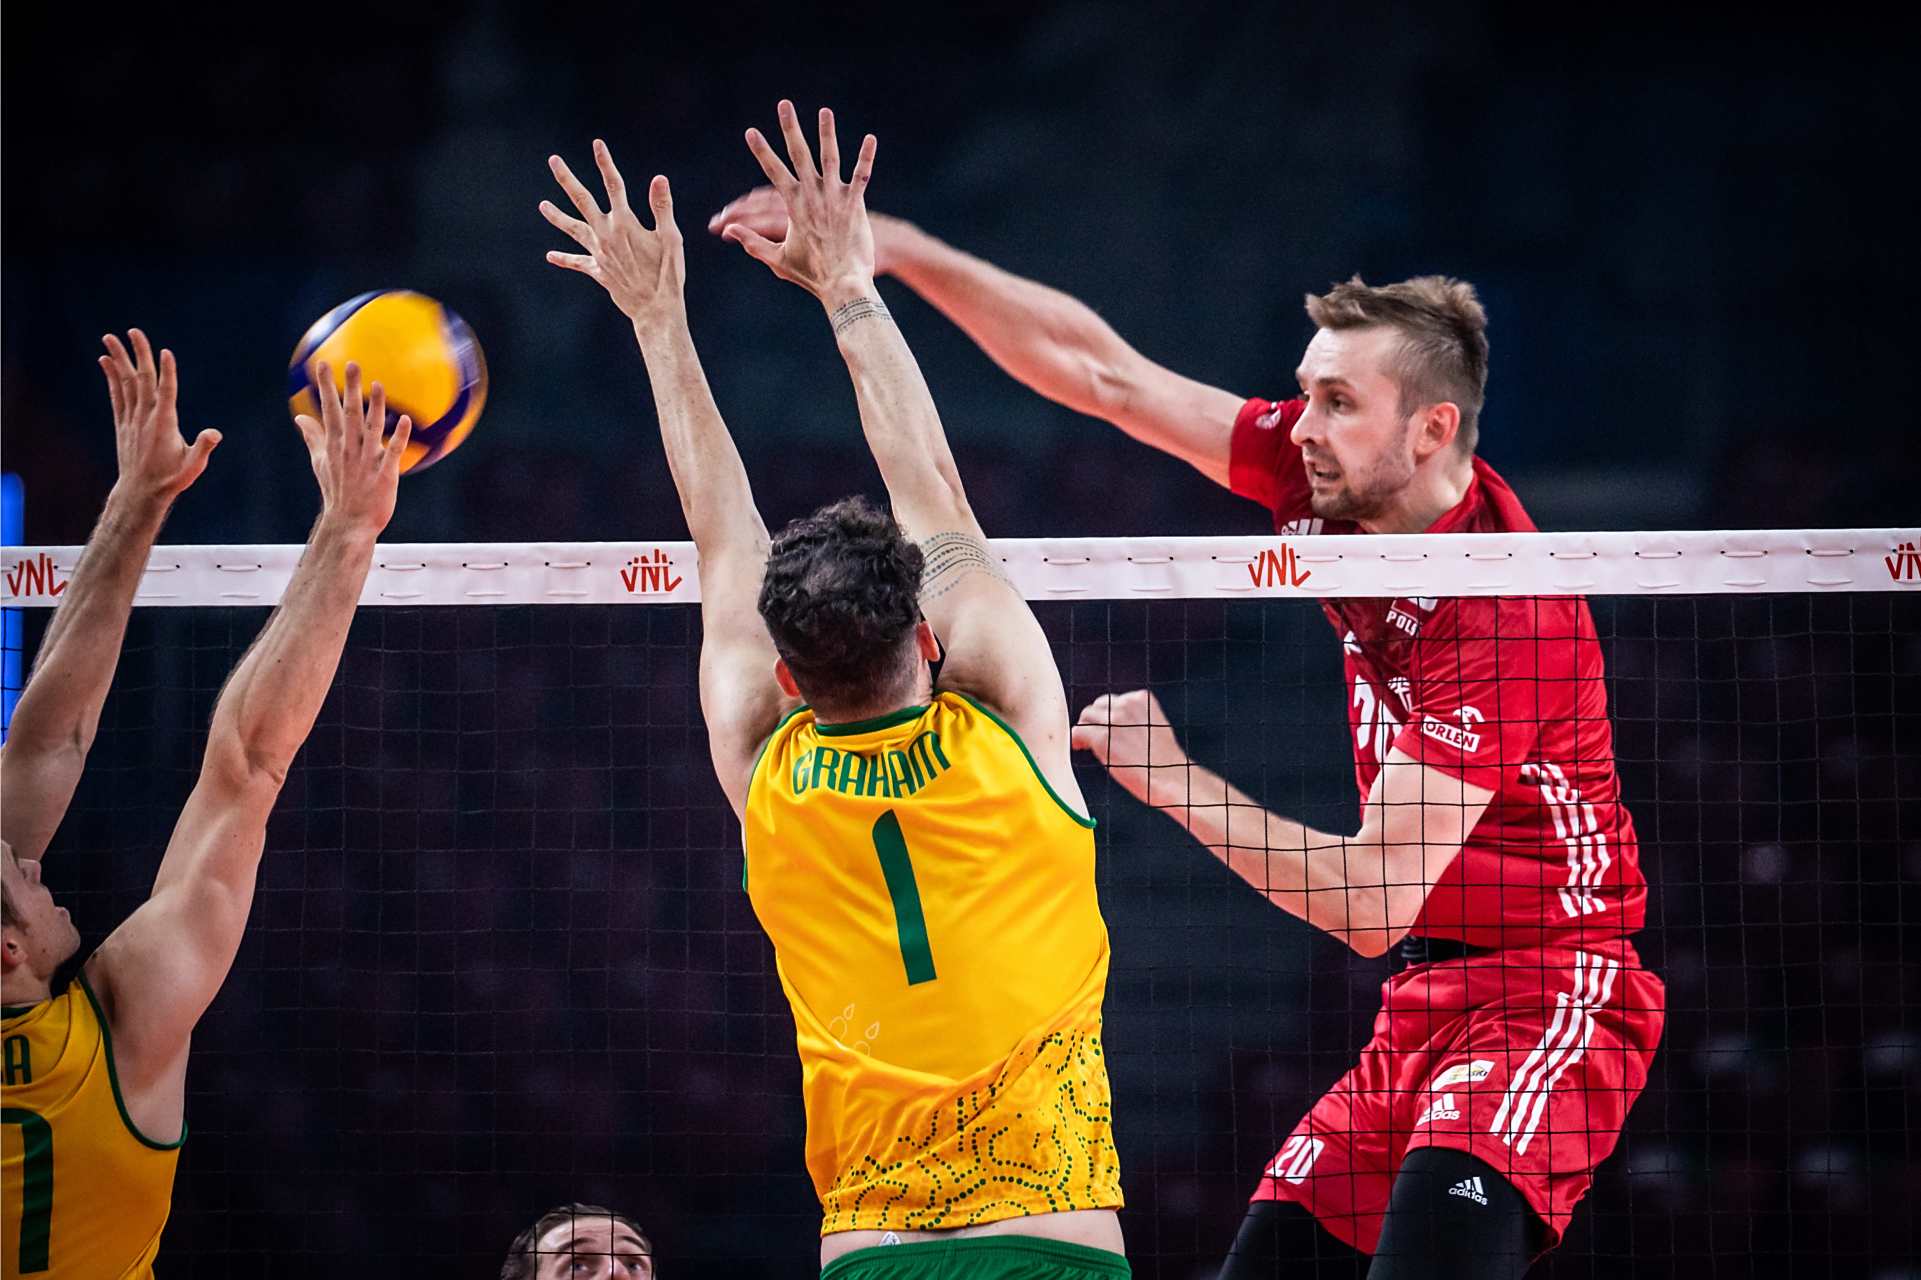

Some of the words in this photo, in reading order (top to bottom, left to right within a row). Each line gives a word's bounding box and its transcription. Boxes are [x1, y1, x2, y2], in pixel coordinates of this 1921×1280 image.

[7, 552, 68, 597] VNL
[620, 549, 682, 592] VNL
[1248, 543, 1311, 588] VNL
[1424, 721, 1477, 749] ORLEN
[791, 730, 952, 799] GRAHAM
[871, 808, 937, 986] 1
[1, 1034, 33, 1086] A
[1265, 1135, 1326, 1186] 20
[1448, 1180, 1489, 1206] adidas
